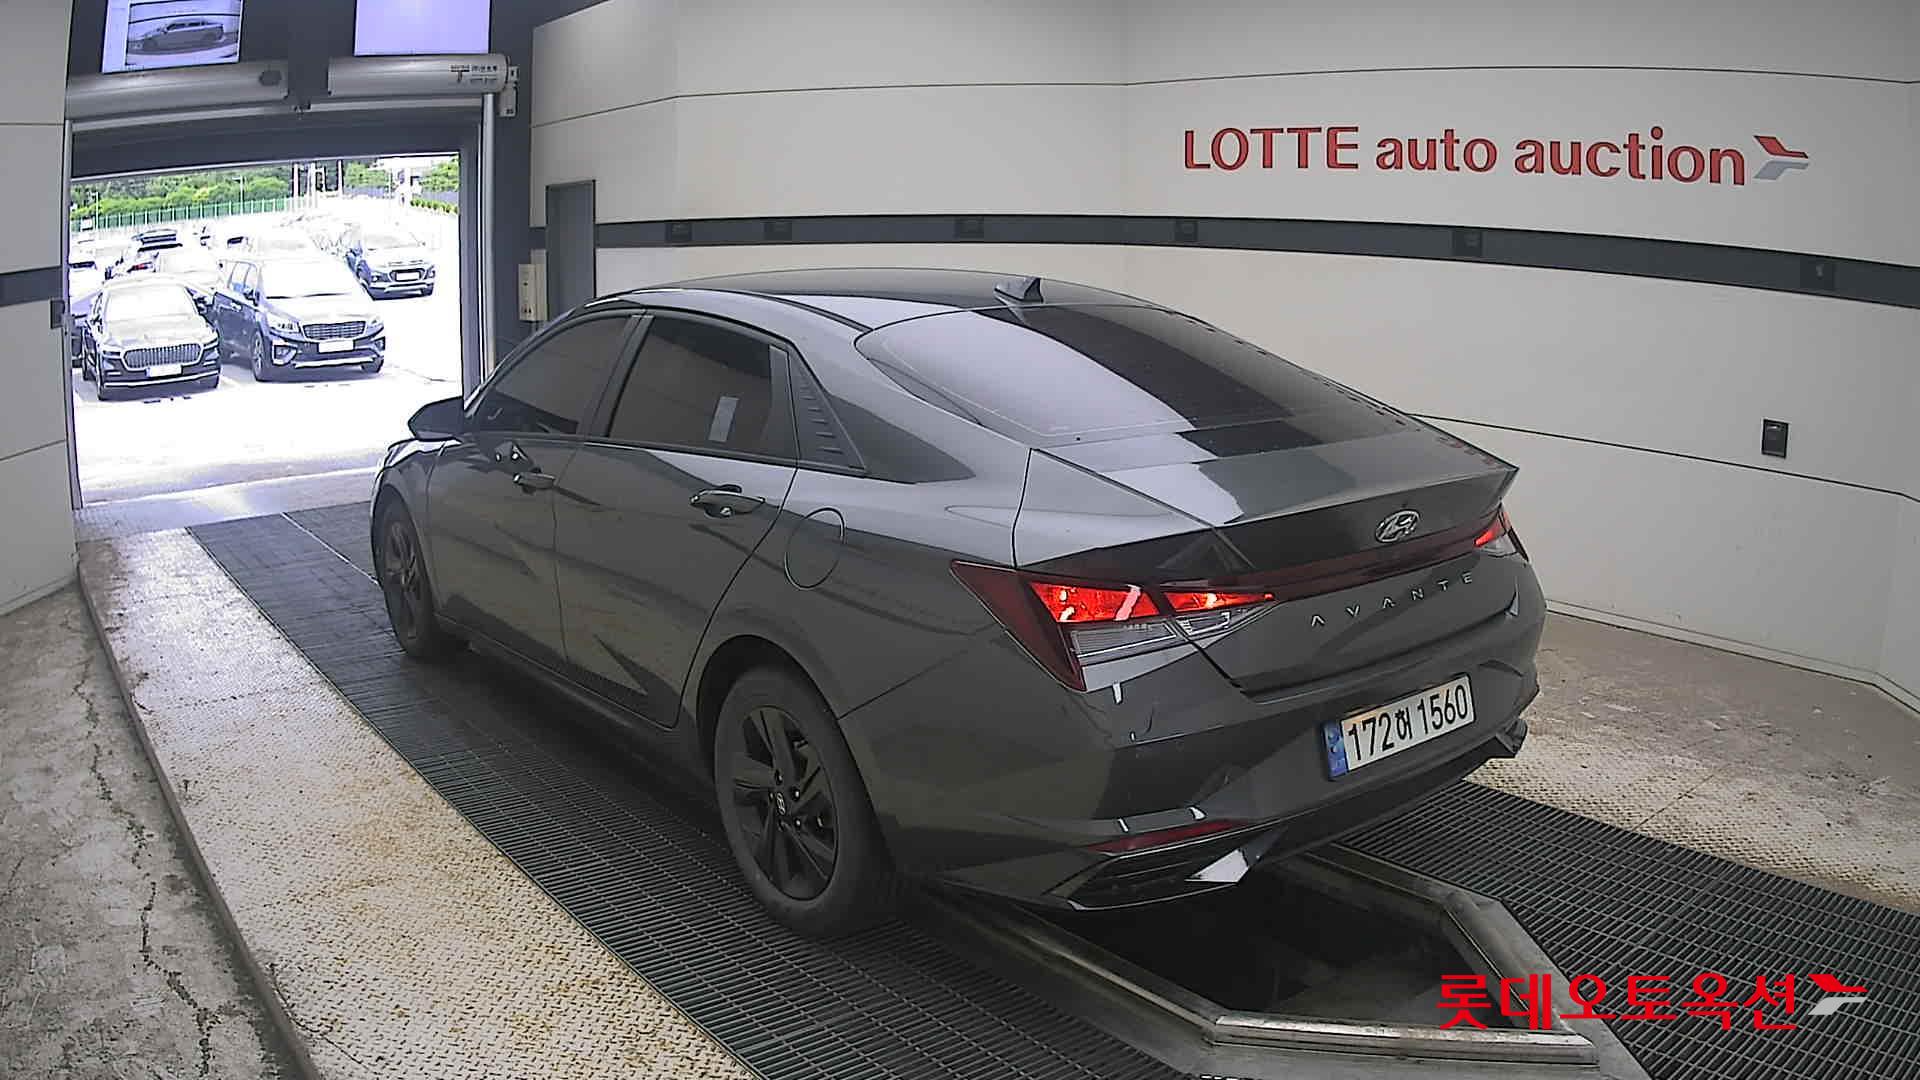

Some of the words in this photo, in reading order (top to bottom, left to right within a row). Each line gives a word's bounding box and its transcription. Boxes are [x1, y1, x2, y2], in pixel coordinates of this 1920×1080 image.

[1184, 126, 1359, 172] LOTTE
[1376, 128, 1497, 174] auto
[1514, 125, 1746, 186] auction
[1311, 571, 1473, 627] AVANTE
[1348, 707, 1413, 761] 172허
[1417, 684, 1468, 735] 1560
